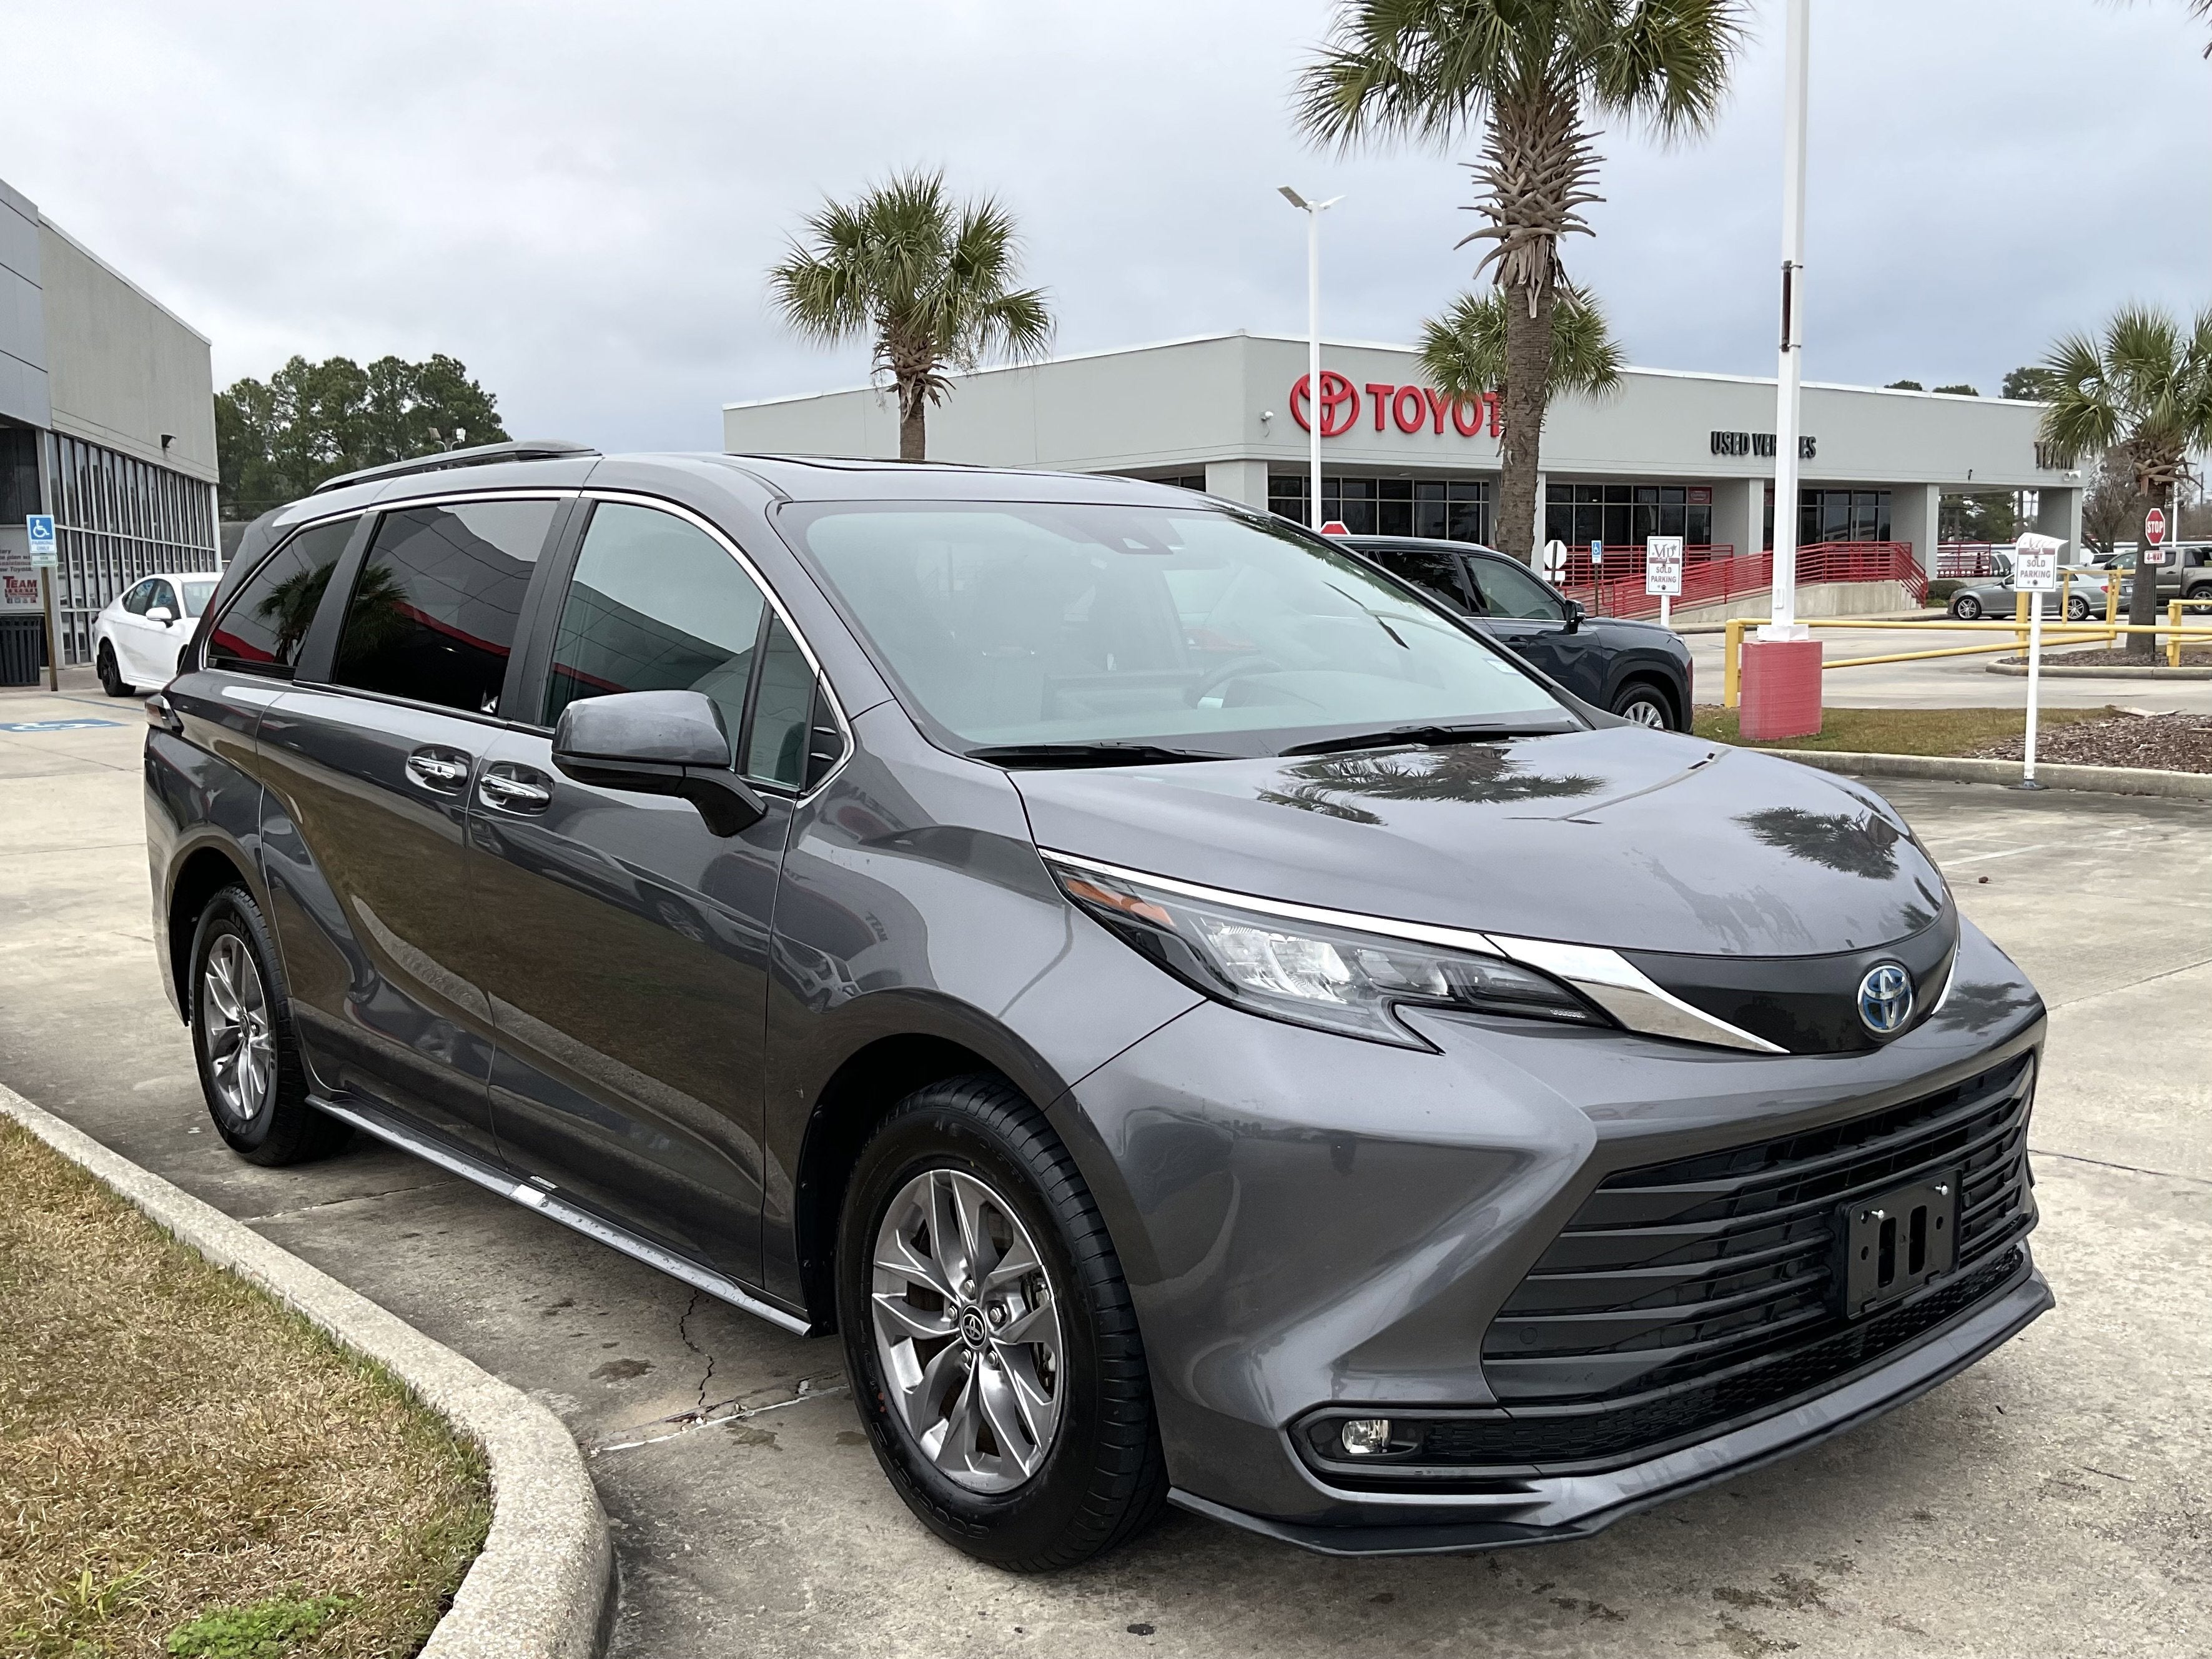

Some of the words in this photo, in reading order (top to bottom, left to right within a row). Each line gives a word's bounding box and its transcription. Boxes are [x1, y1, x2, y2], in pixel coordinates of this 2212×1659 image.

[1366, 384, 1500, 437] TOYOT
[1711, 431, 1750, 455] USED
[2147, 520, 2163, 533] STOP
[2146, 552, 2163, 561] 4-WAY
[2020, 570, 2051, 578] PARKING
[2, 576, 37, 588] TEAM
